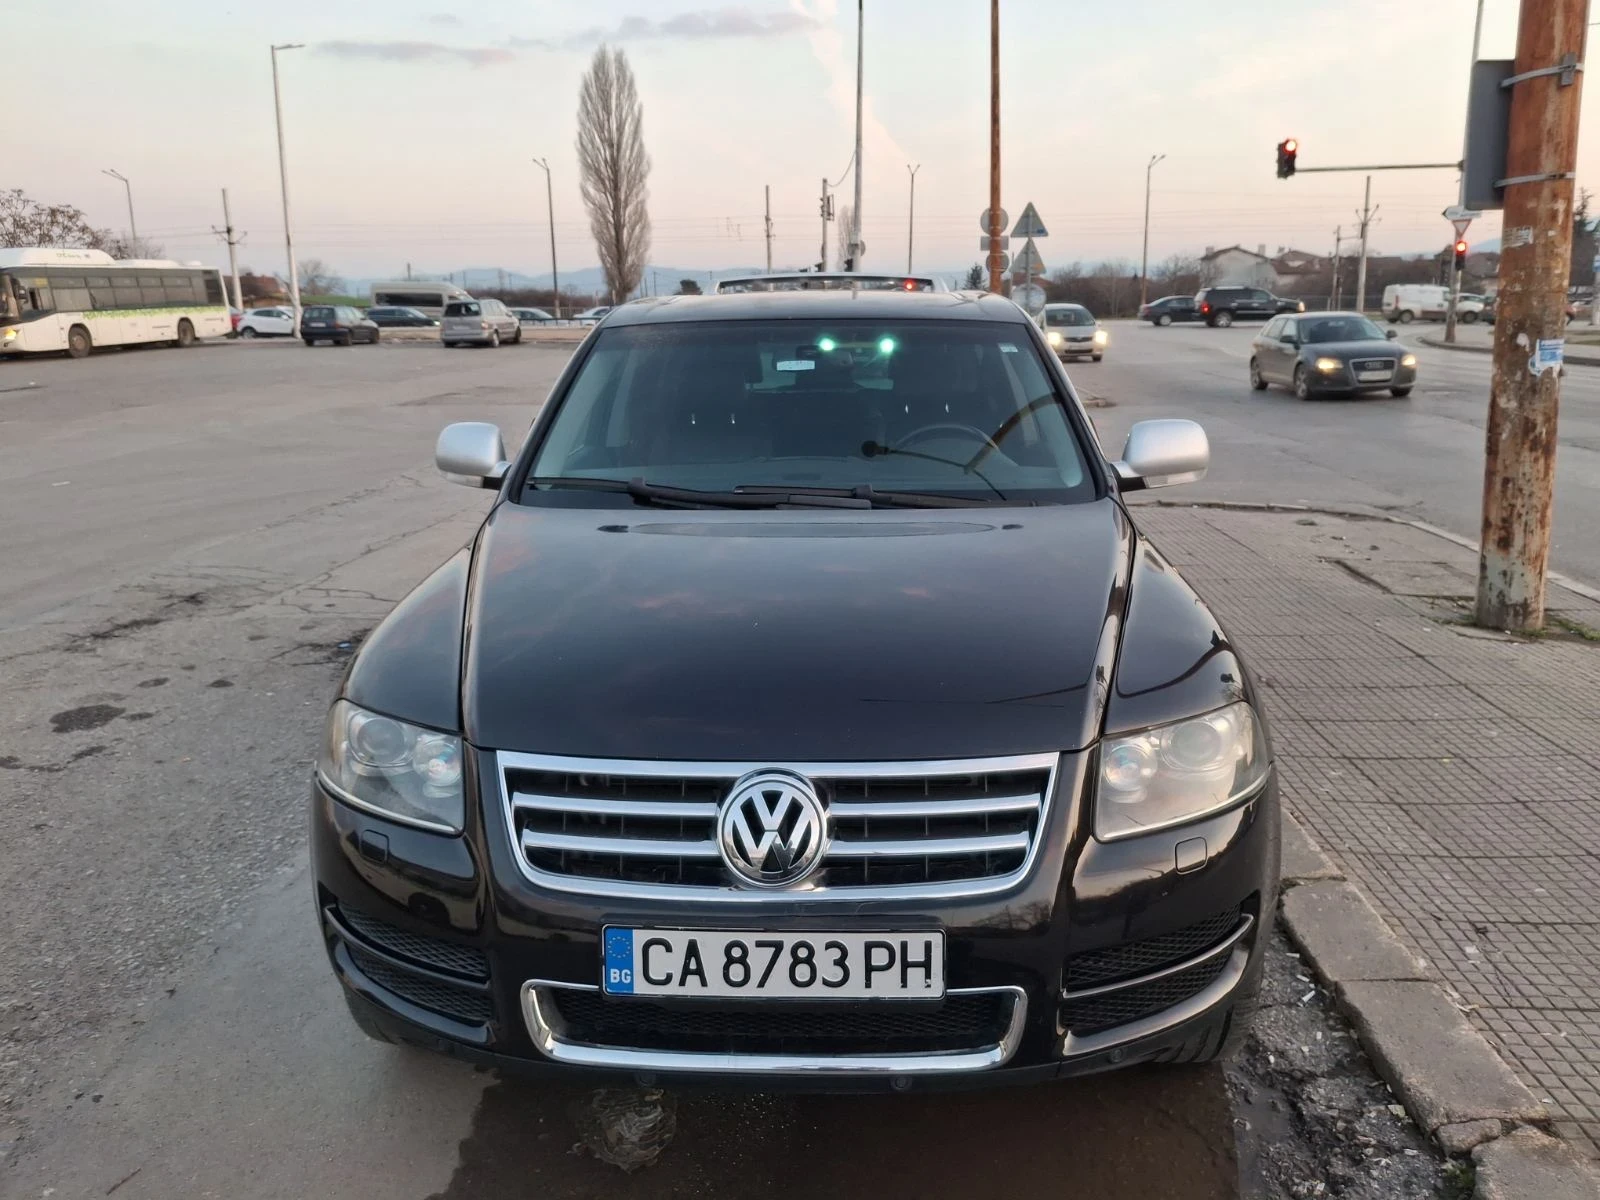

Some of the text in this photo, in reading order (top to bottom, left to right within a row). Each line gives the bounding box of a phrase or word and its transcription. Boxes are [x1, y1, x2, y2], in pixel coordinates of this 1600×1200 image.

[724, 780, 820, 880] VW
[610, 968, 631, 984] BG
[641, 937, 933, 989] CA 8783 PH
